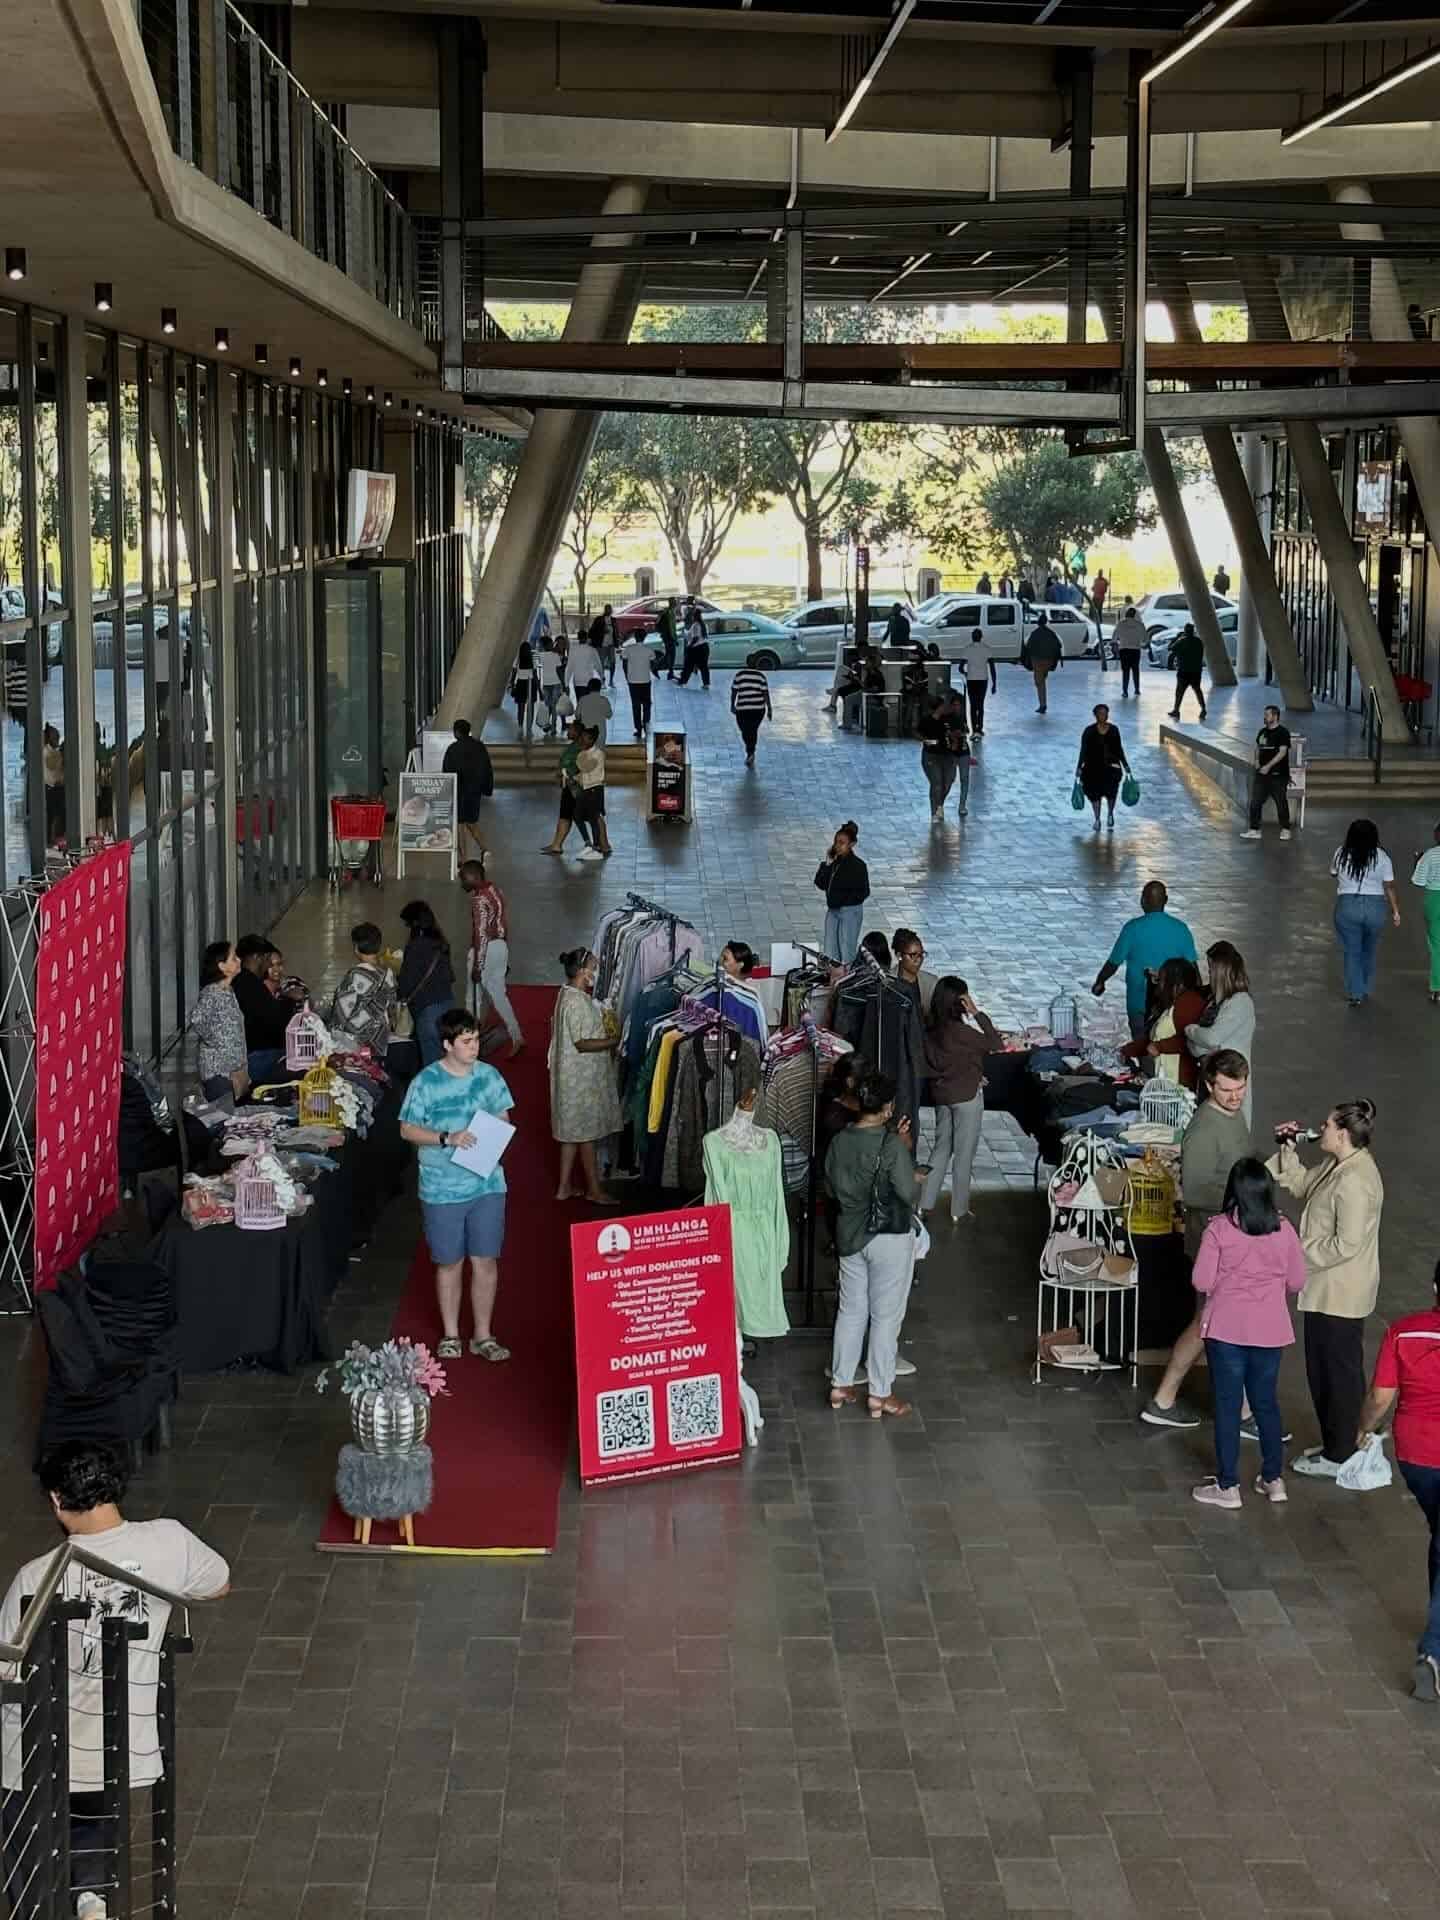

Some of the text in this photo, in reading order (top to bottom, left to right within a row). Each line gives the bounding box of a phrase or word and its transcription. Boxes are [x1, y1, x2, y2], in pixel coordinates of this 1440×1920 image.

[633, 1218, 709, 1238] UMHLANGA
[667, 1229, 709, 1241] ASSOCIATION
[586, 1270, 608, 1281] HELP
[610, 1268, 622, 1278] US
[624, 1265, 647, 1276] WITH
[648, 1256, 700, 1273] DONATIONS
[610, 1344, 707, 1371] DONATE NOW
